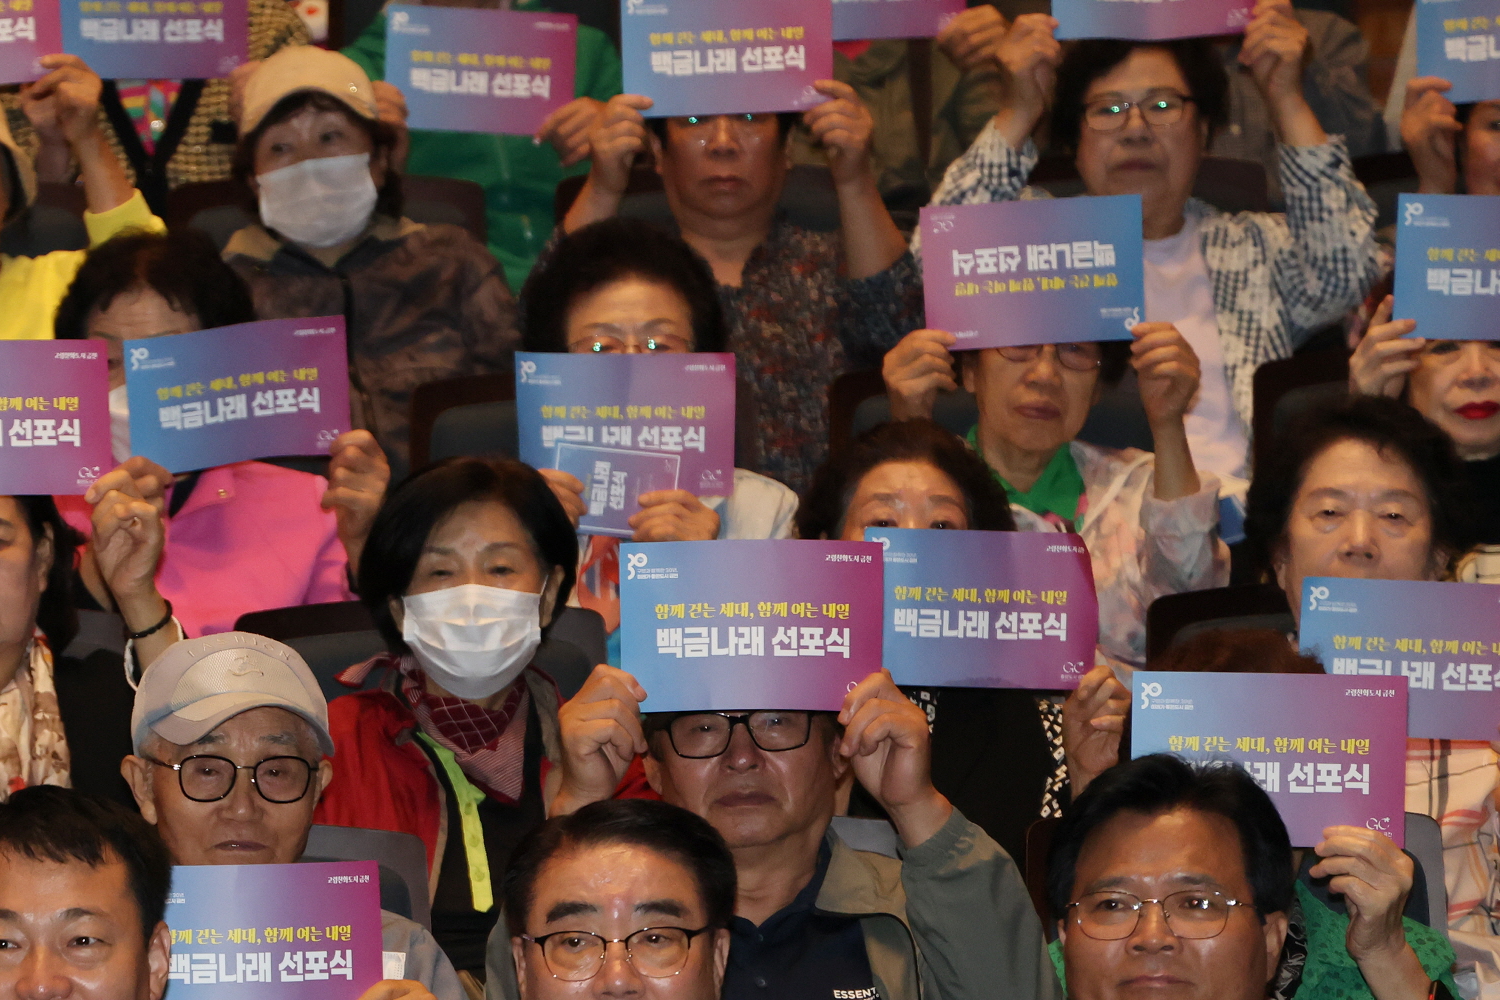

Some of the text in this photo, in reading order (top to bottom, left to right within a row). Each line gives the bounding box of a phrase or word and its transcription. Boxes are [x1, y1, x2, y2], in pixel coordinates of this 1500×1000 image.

[651, 45, 804, 76] 백금나래 선포식
[411, 68, 549, 98] 백금나래 선포식
[159, 384, 319, 431] 백금나래 선포식
[8, 418, 80, 447] 선포식
[637, 426, 704, 452] 선포식
[654, 602, 685, 618] 함께
[757, 602, 787, 618] 함께
[791, 602, 818, 618] 여는
[822, 602, 850, 618] 내일
[895, 586, 921, 601] 함께
[983, 588, 1010, 603] 함께
[1013, 589, 1038, 604] 여는
[1041, 590, 1066, 605] 내일
[894, 608, 1066, 641] 백금나래 선포식
[656, 626, 850, 657] 백금나래 선포식
[1168, 735, 1199, 751] 함께
[1273, 737, 1305, 753] 함께
[1308, 738, 1337, 754] 여는
[1340, 738, 1369, 755] 내일
[1287, 762, 1369, 794] 선포식
[263, 927, 293, 942] 함께
[296, 926, 322, 942] 여는
[325, 926, 352, 942] 내일
[168, 949, 352, 985] 백금나래 선포식
